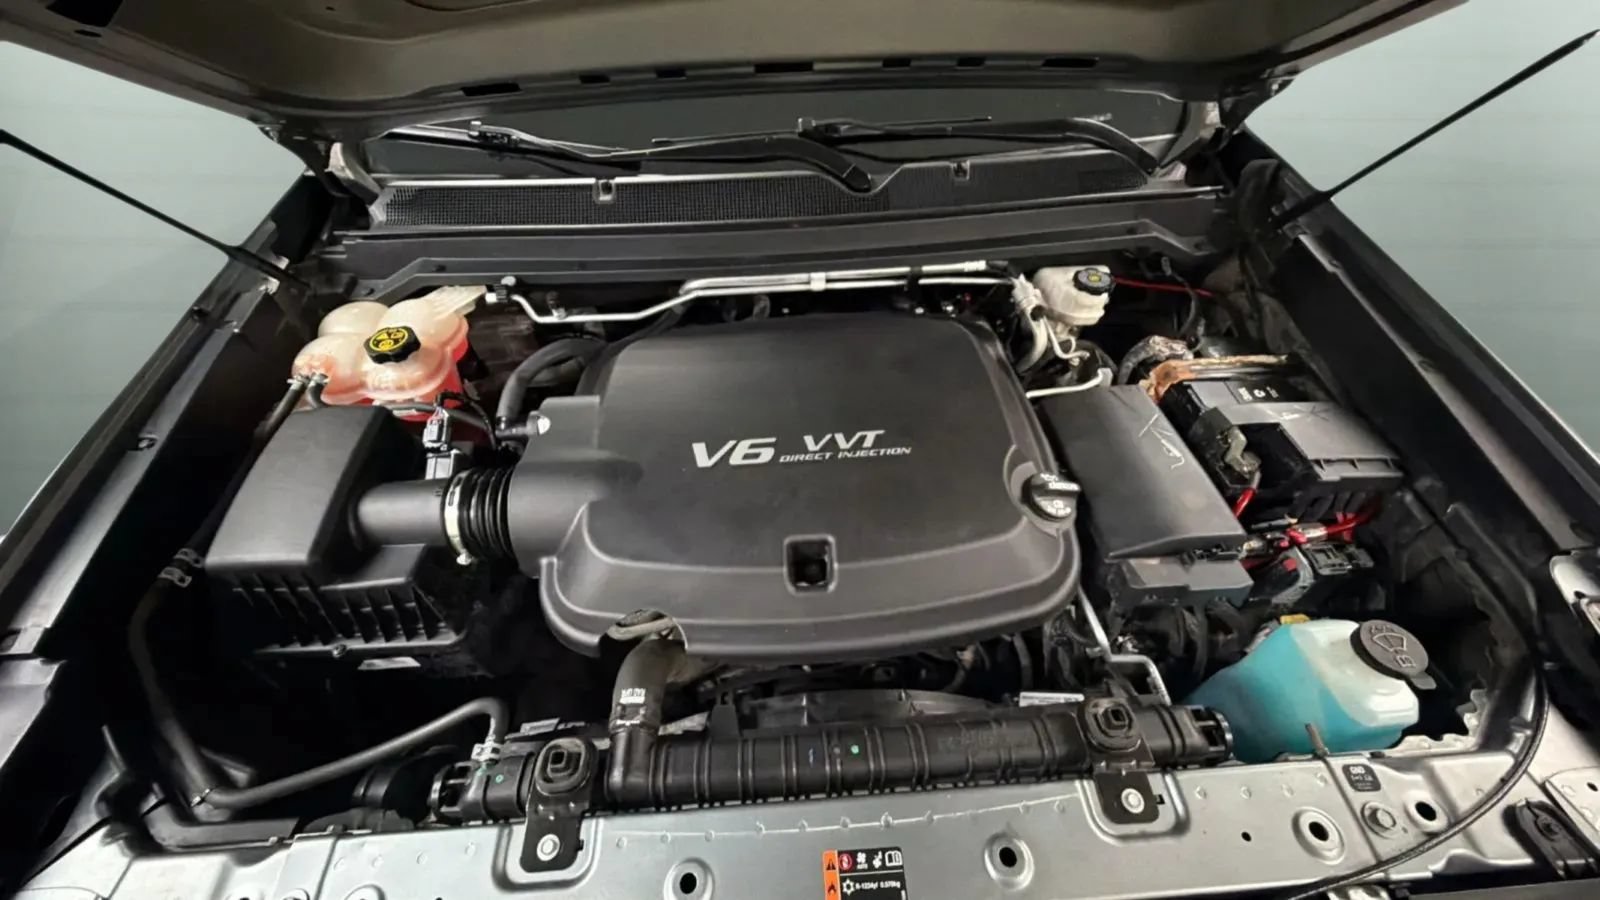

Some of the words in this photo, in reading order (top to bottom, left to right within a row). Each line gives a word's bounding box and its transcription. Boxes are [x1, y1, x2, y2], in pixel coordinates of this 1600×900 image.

[691, 437, 777, 468] V6
[803, 430, 886, 452] VVT
[779, 452, 832, 463] DIRECT
[837, 447, 912, 459] INJECTION
